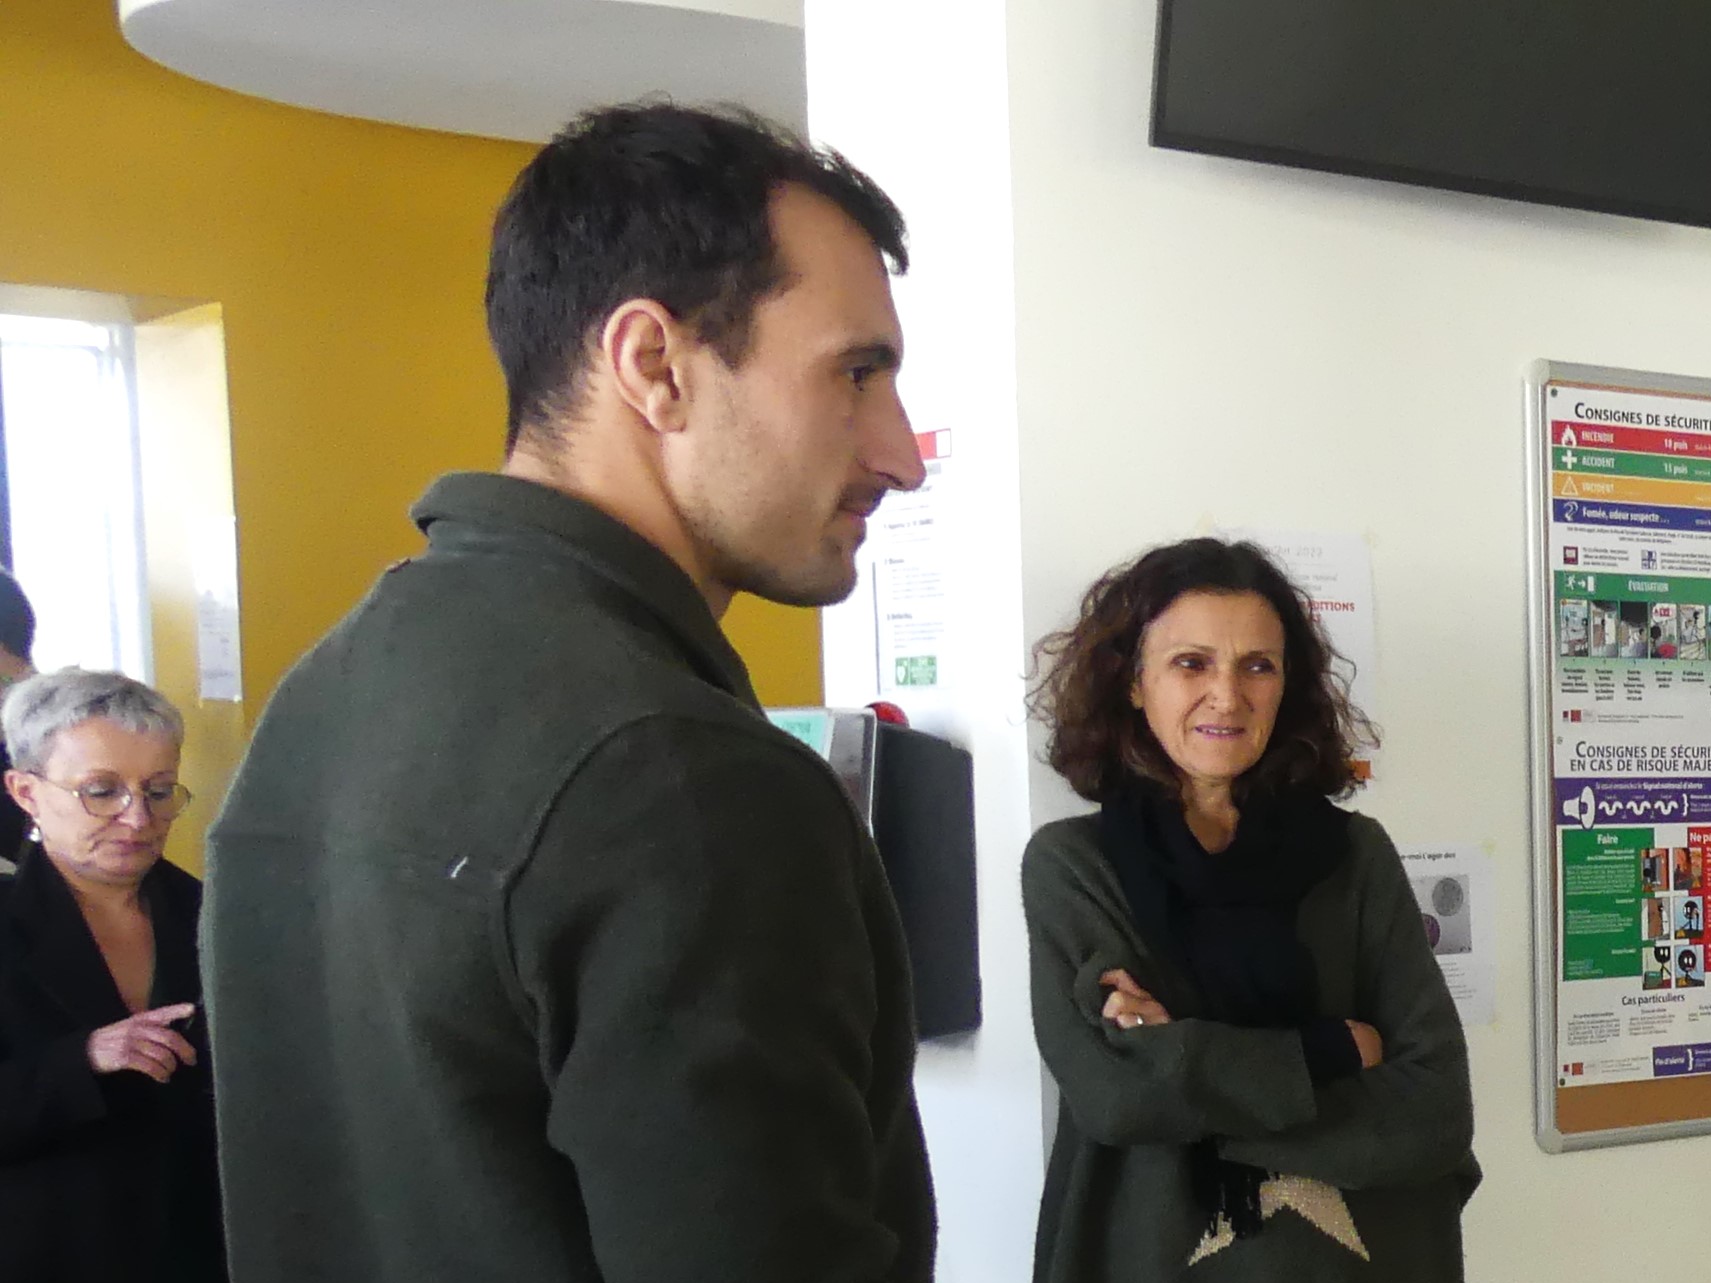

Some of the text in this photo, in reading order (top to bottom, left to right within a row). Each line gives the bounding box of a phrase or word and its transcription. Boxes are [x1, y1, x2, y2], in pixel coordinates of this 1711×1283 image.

[1574, 402, 1643, 425] CONSIGNES
[1646, 413, 1661, 427] DE
[1581, 456, 1616, 469] ACCIDENT
[1575, 740, 1647, 759] CONSIGNES
[1651, 746, 1666, 759] DE
[1570, 759, 1586, 772] EN
[1589, 759, 1614, 772] CAS
[1621, 759, 1633, 772] DE
[1636, 758, 1680, 773] RISQUE
[1597, 833, 1619, 845] Faire
[1689, 832, 1702, 842] Ne
[1621, 993, 1686, 1007] Cas particuliers
